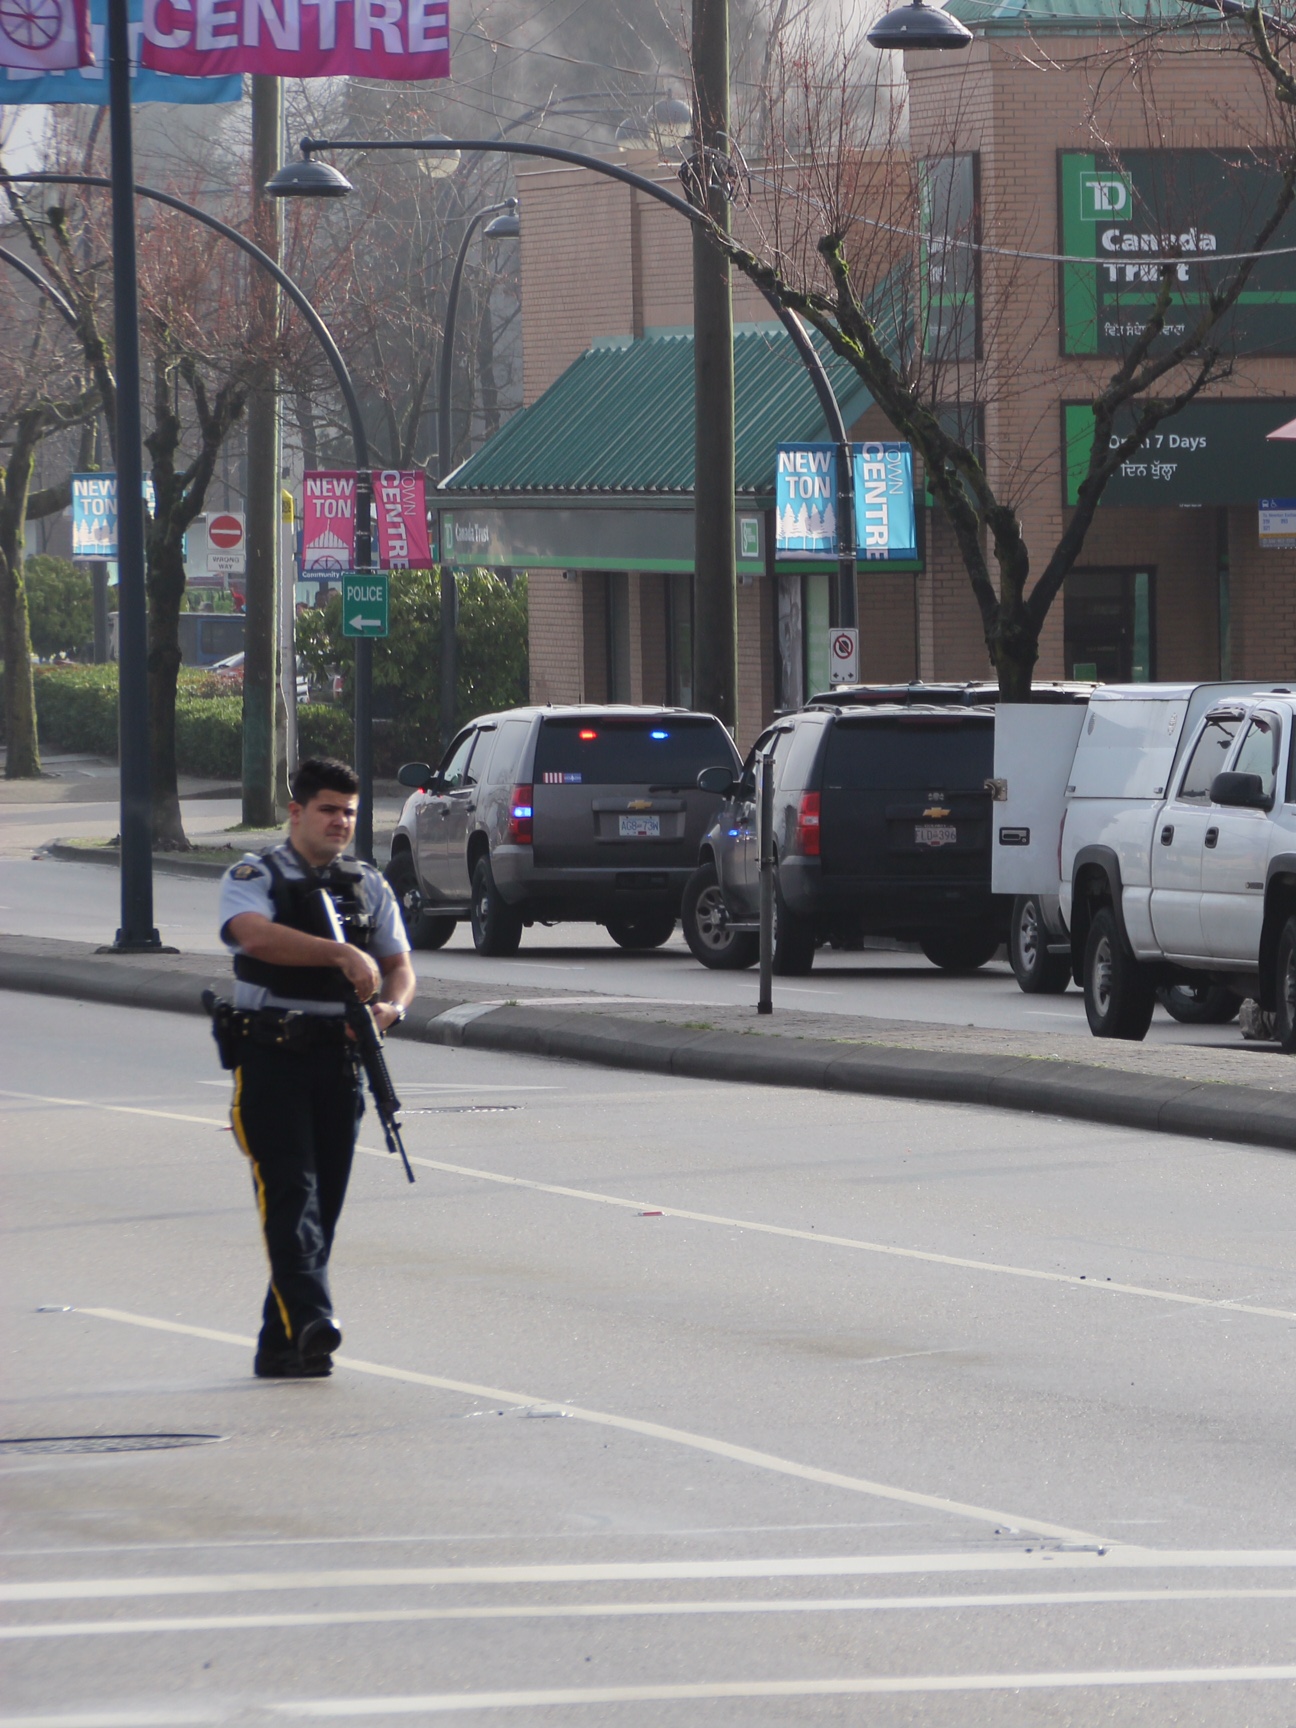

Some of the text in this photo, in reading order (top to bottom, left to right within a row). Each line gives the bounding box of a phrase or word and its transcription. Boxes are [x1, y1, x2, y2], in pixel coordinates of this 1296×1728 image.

[142, 0, 450, 54] CENTRE
[1085, 181, 1127, 211] TD
[1155, 435, 1164, 448] 7
[1169, 435, 1207, 451] Days
[779, 451, 831, 473] NEW
[307, 478, 354, 496] NEW
[401, 470, 416, 516] TOWN
[785, 476, 831, 499] TON
[312, 499, 352, 518] TON
[862, 442, 889, 560] CENTRE
[380, 470, 410, 570] CENTRE
[302, 570, 340, 579] Community
[347, 586, 383, 601] POLICE
